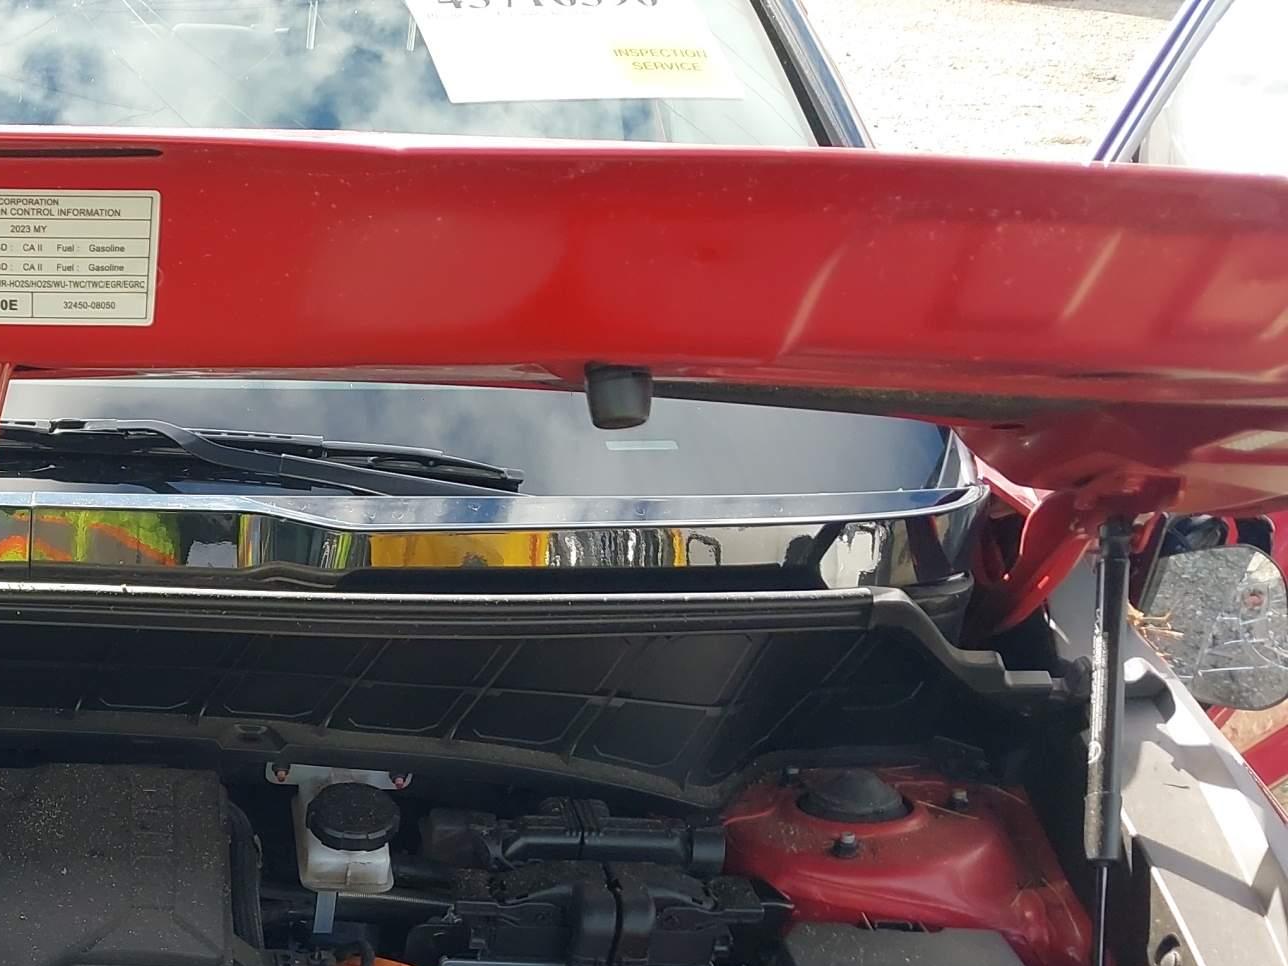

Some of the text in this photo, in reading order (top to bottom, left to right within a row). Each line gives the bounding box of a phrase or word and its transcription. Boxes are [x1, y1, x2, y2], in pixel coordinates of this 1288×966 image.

[613, 49, 708, 58] INSPECTION
[631, 62, 703, 72] SERVICE
[10, 208, 54, 217] CONTROL
[57, 208, 121, 217] INFORMATION
[10, 224, 47, 233] 2023 MY
[22, 243, 38, 252] CA
[88, 244, 125, 252] Gasoline
[22, 263, 38, 272] CA
[88, 263, 125, 272] Gasoline
[63, 301, 116, 310] 32450-08050
